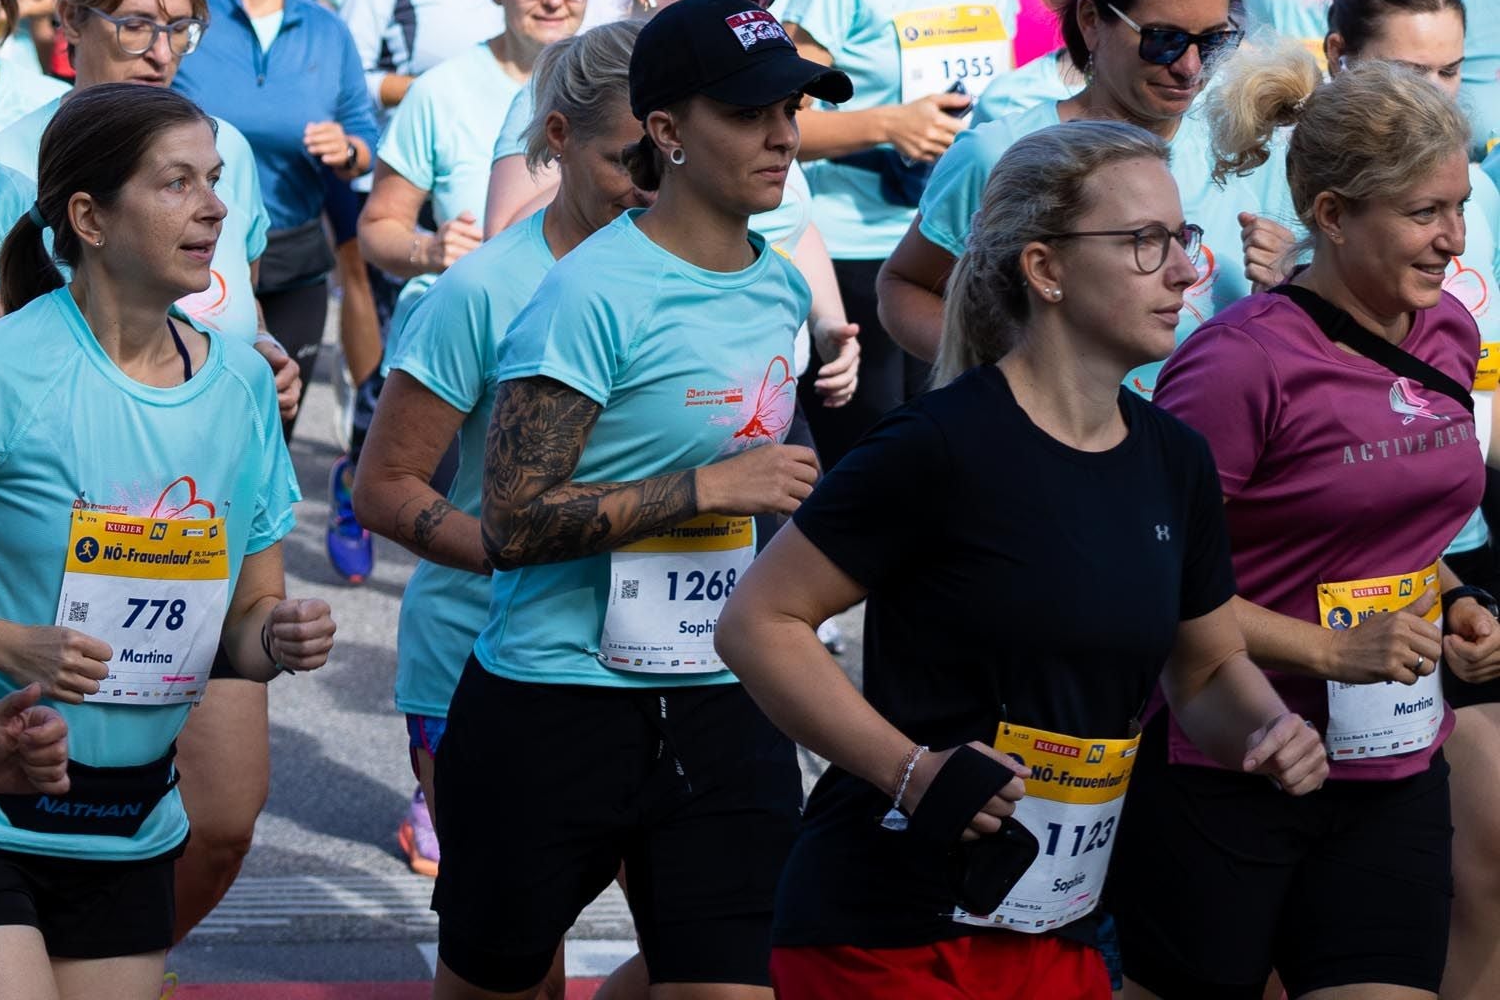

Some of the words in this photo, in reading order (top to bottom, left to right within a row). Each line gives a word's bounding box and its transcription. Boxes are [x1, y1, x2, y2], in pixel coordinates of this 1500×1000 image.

[942, 56, 994, 79] 1355
[1343, 434, 1427, 464] ACTIVE
[106, 522, 143, 534] KURIER
[103, 543, 191, 565] NÖ-Frauenlauf
[667, 568, 736, 601] 1268
[1353, 586, 1391, 598] KURIER
[122, 598, 187, 631] 778
[678, 619, 717, 637] Sophi
[120, 649, 173, 664] Martina
[1393, 697, 1434, 716] Martina
[1036, 741, 1079, 757] KURIER
[1030, 763, 1124, 789] NÖ-Frauenlauf
[36, 795, 144, 818] NATHAN
[1046, 815, 1116, 857] 1123
[1052, 871, 1087, 894] Sophie
